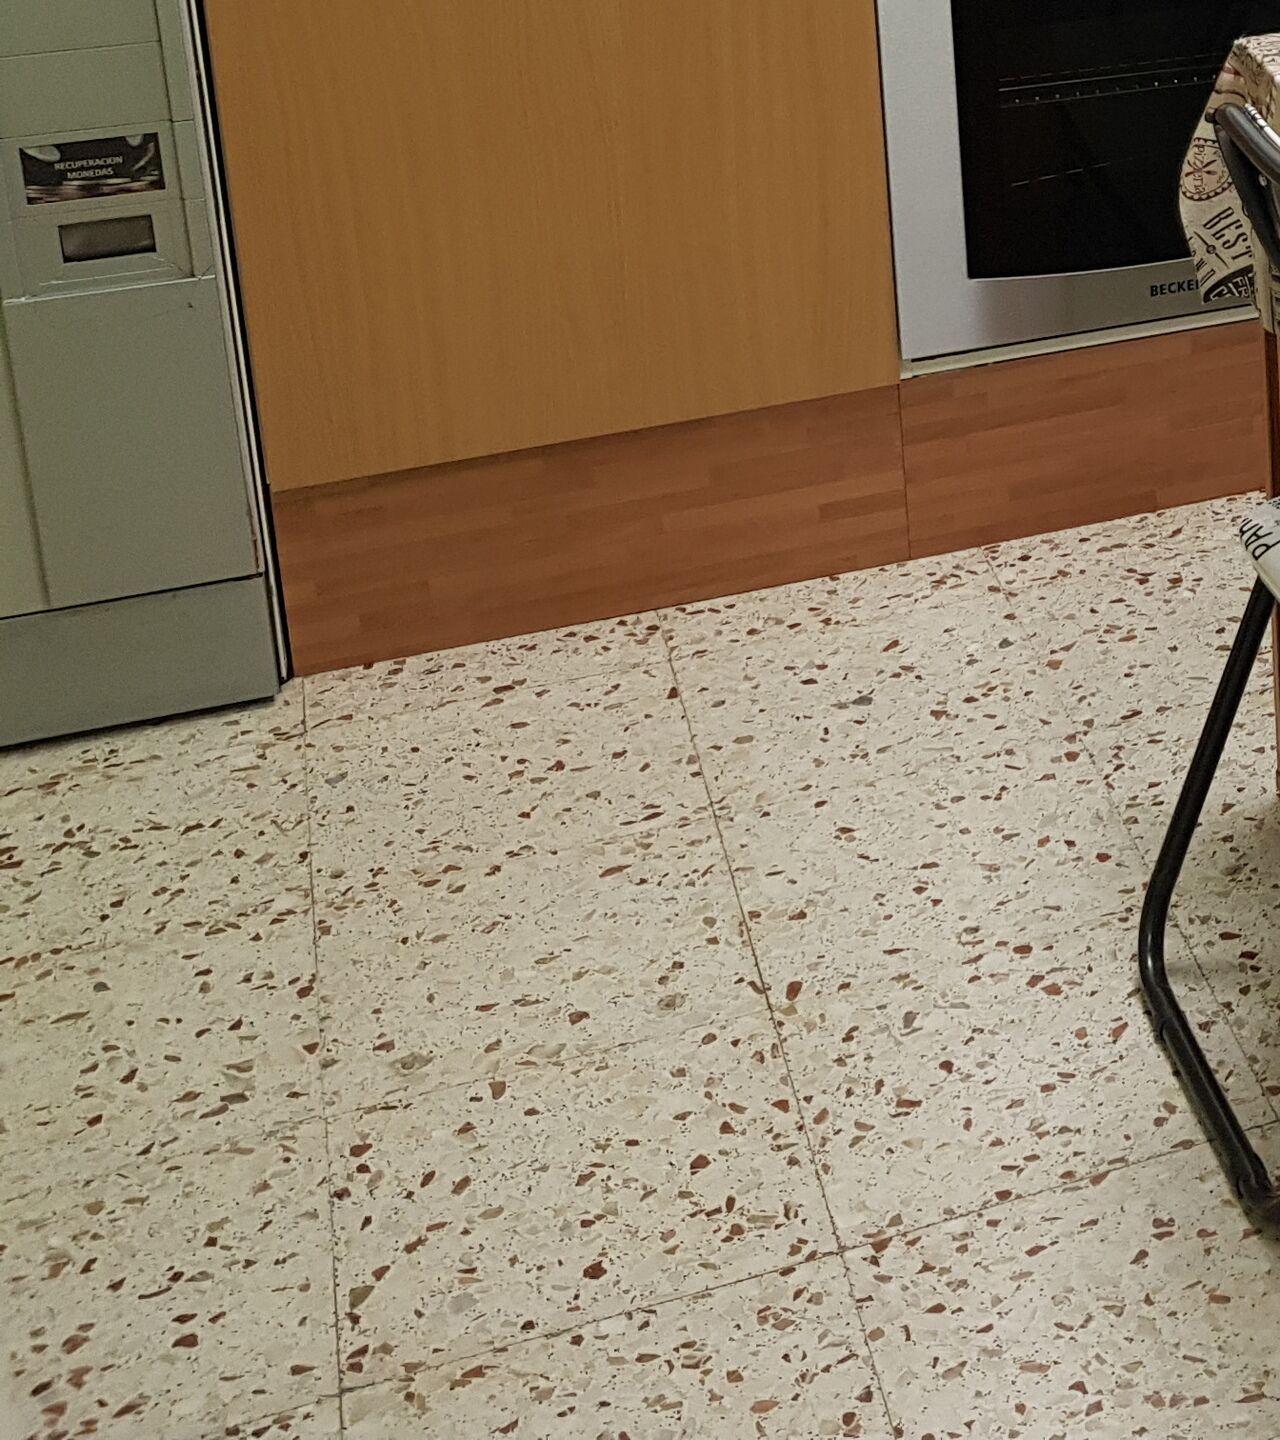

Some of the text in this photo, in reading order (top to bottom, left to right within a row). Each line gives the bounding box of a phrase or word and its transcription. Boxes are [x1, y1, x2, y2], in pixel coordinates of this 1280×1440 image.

[54, 156, 124, 171] RECUPERACION
[67, 167, 114, 179] MONEDAS
[1203, 205, 1253, 261] BEST
